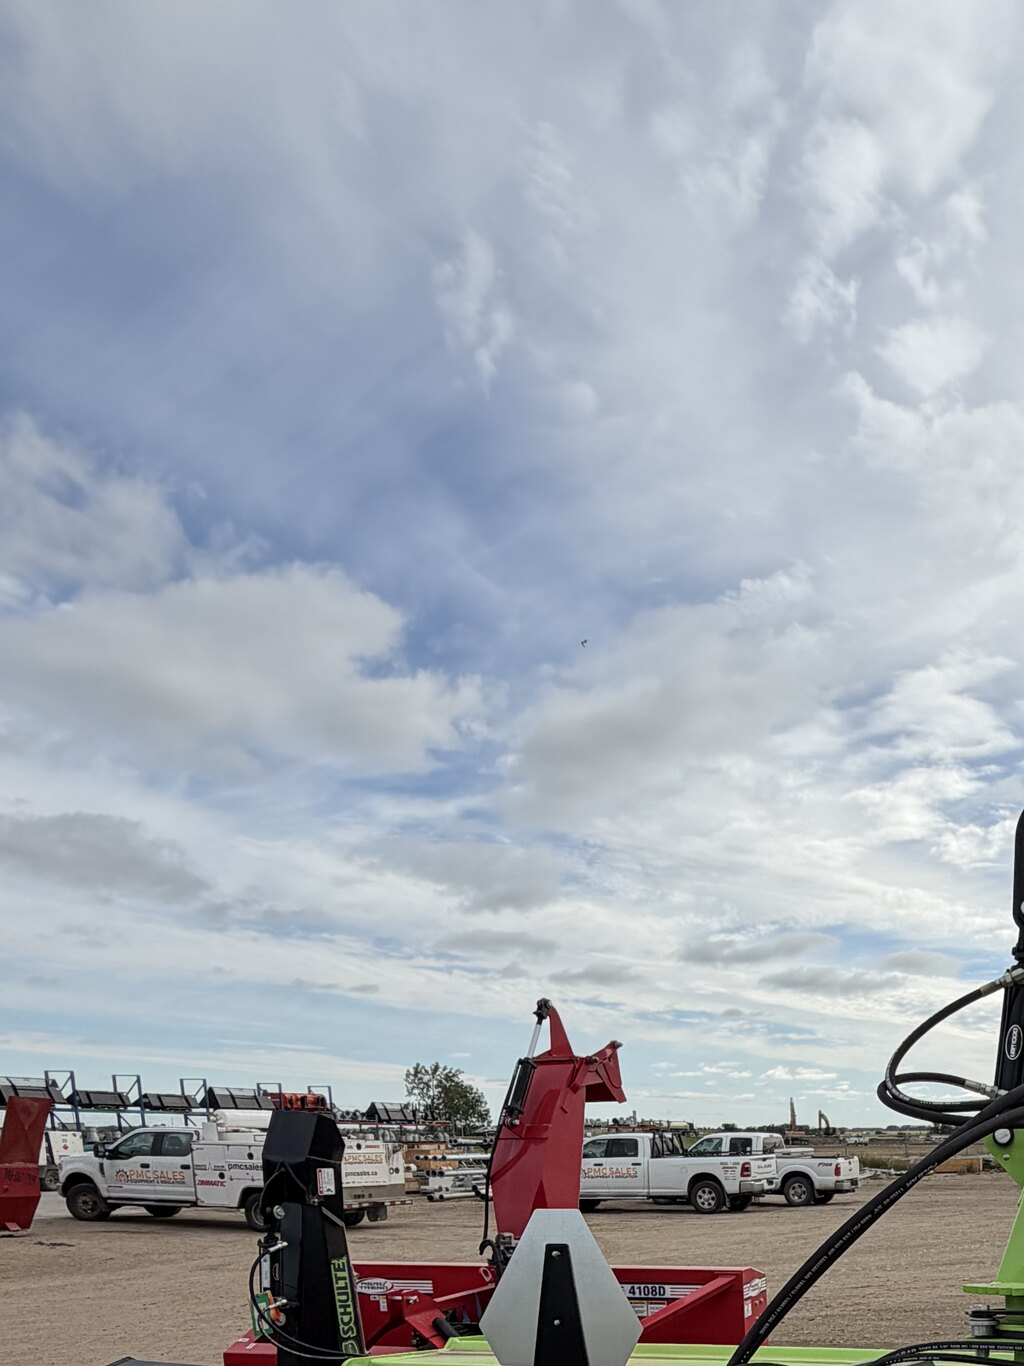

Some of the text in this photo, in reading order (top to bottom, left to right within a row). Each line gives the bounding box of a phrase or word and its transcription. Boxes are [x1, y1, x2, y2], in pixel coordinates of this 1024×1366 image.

[129, 1169, 186, 1180] PMC SALES
[587, 1167, 638, 1176] PMC SALES
[628, 1285, 666, 1297] 4108D
[331, 1256, 357, 1338] SCHULTE
